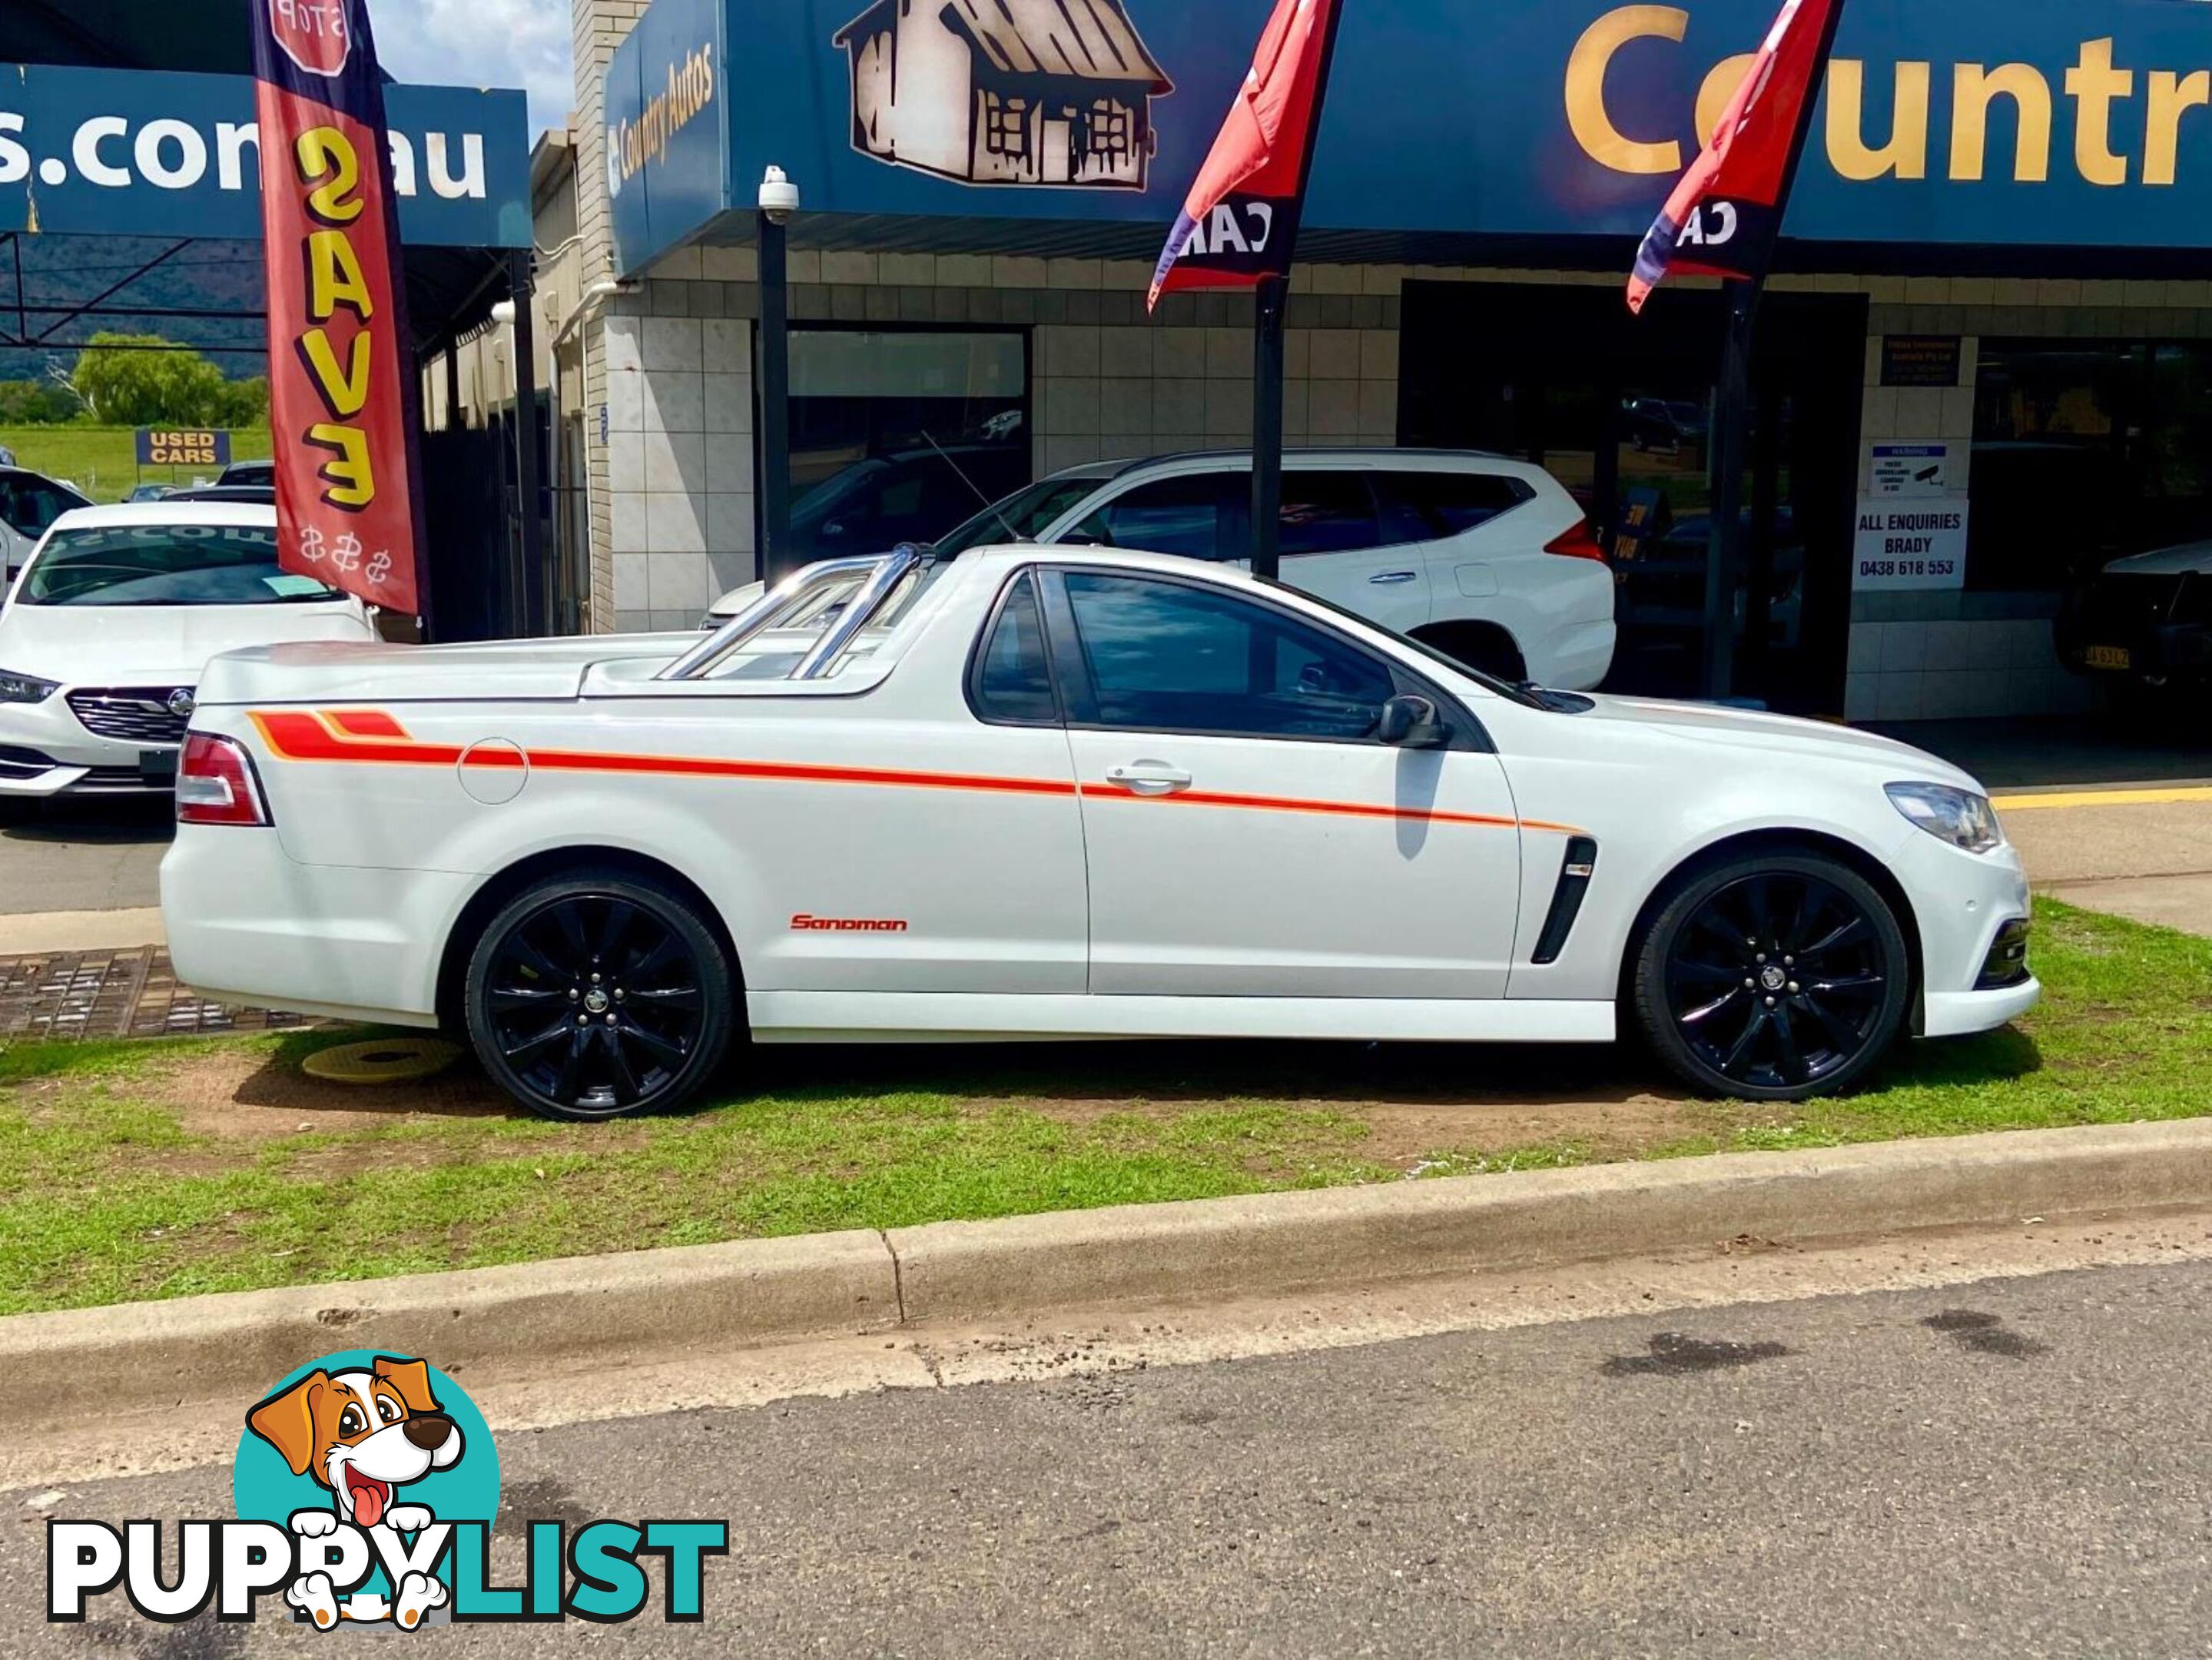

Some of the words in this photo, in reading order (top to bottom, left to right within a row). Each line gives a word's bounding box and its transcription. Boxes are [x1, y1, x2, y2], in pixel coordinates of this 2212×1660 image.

[620, 91, 666, 181] Country
[668, 42, 712, 137] Autos
[150, 432, 215, 447] USED
[151, 448, 216, 463] CARS
[1859, 514, 1883, 530] ALL
[1888, 513, 1961, 531] ENQUIRIES
[1885, 538, 1933, 553] BRADY
[1860, 561, 1895, 576] 0438
[1899, 560, 1924, 575] 618
[1928, 560, 1955, 575] 553
